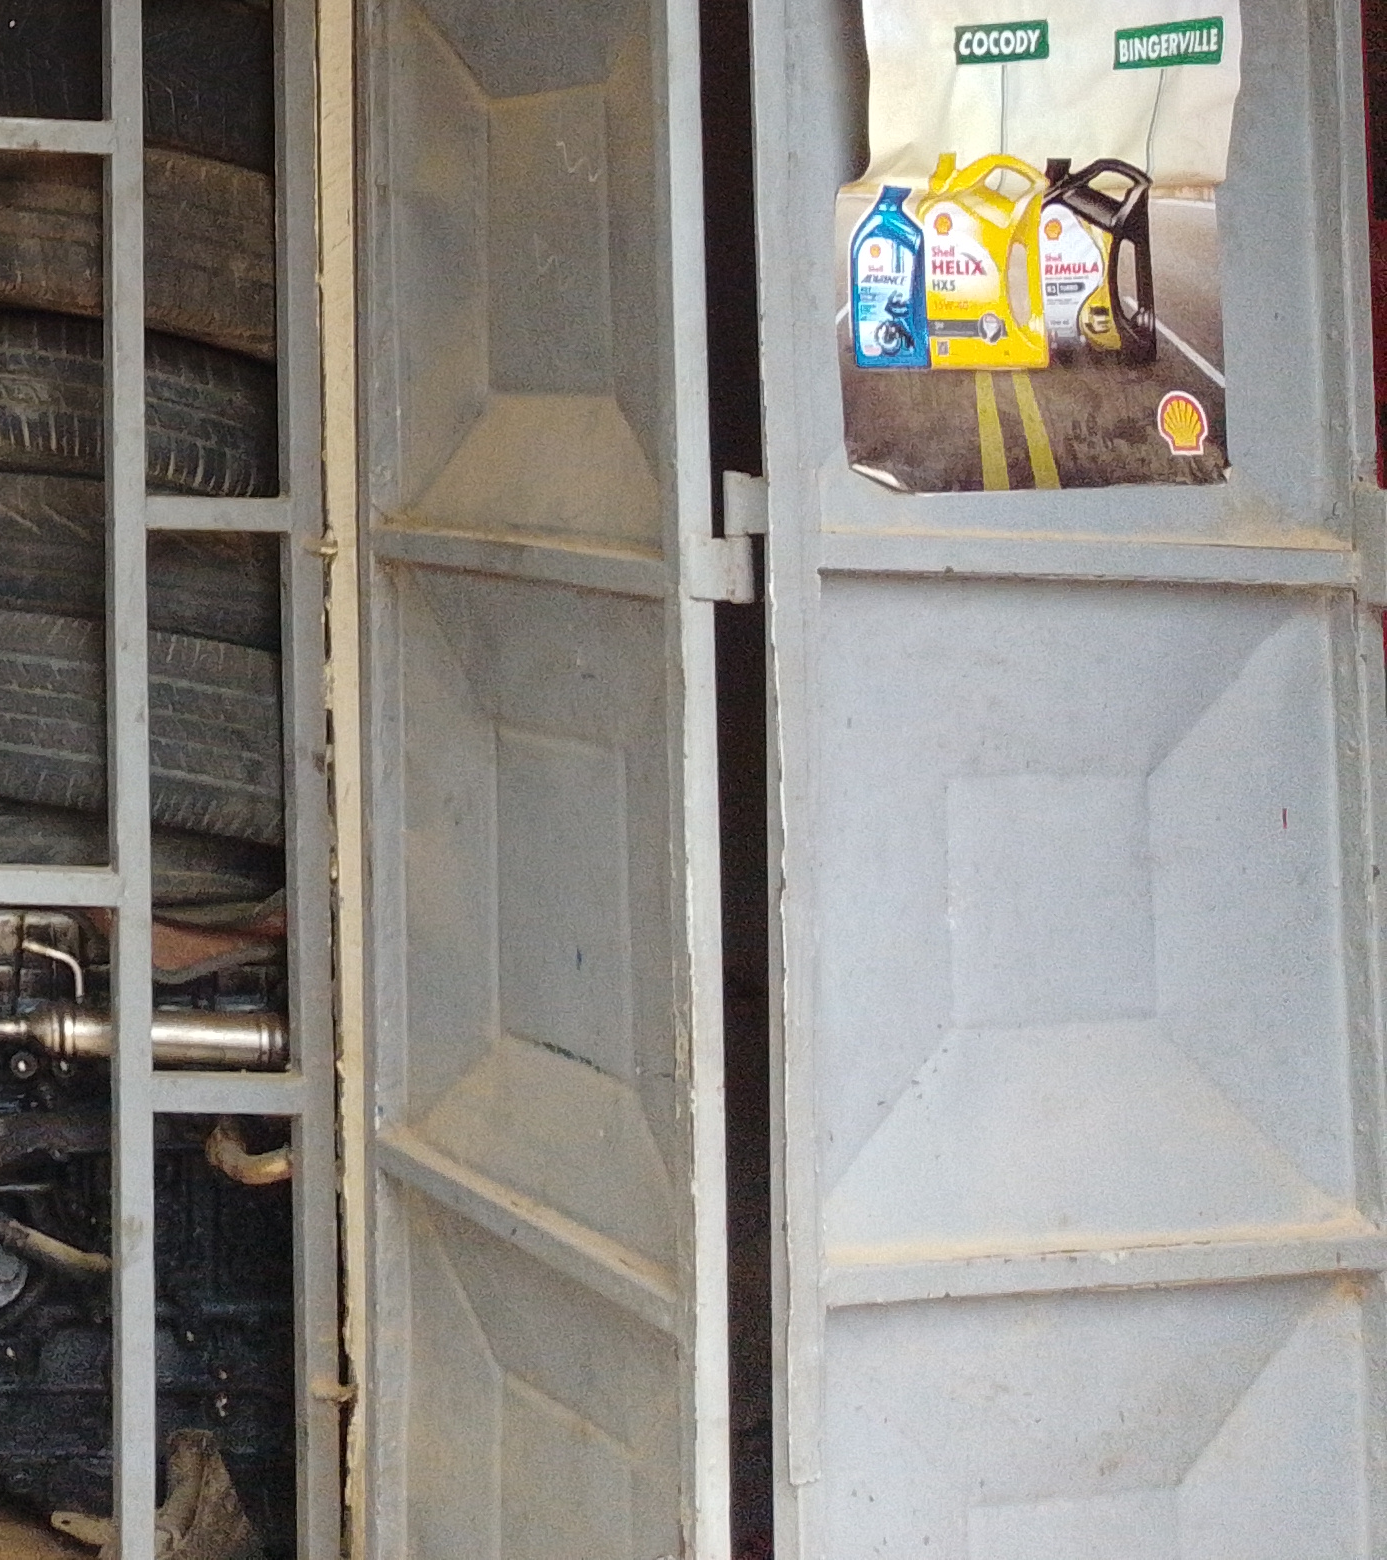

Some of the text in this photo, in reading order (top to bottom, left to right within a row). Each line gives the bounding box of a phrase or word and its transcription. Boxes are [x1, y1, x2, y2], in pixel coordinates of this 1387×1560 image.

[958, 29, 1041, 56] COCODY
[1118, 26, 1219, 62] BINGERVILLE
[931, 245, 955, 258] Shell
[931, 259, 984, 276] HELIX
[1045, 262, 1100, 275] RIMULA
[932, 279, 956, 292] HX5
